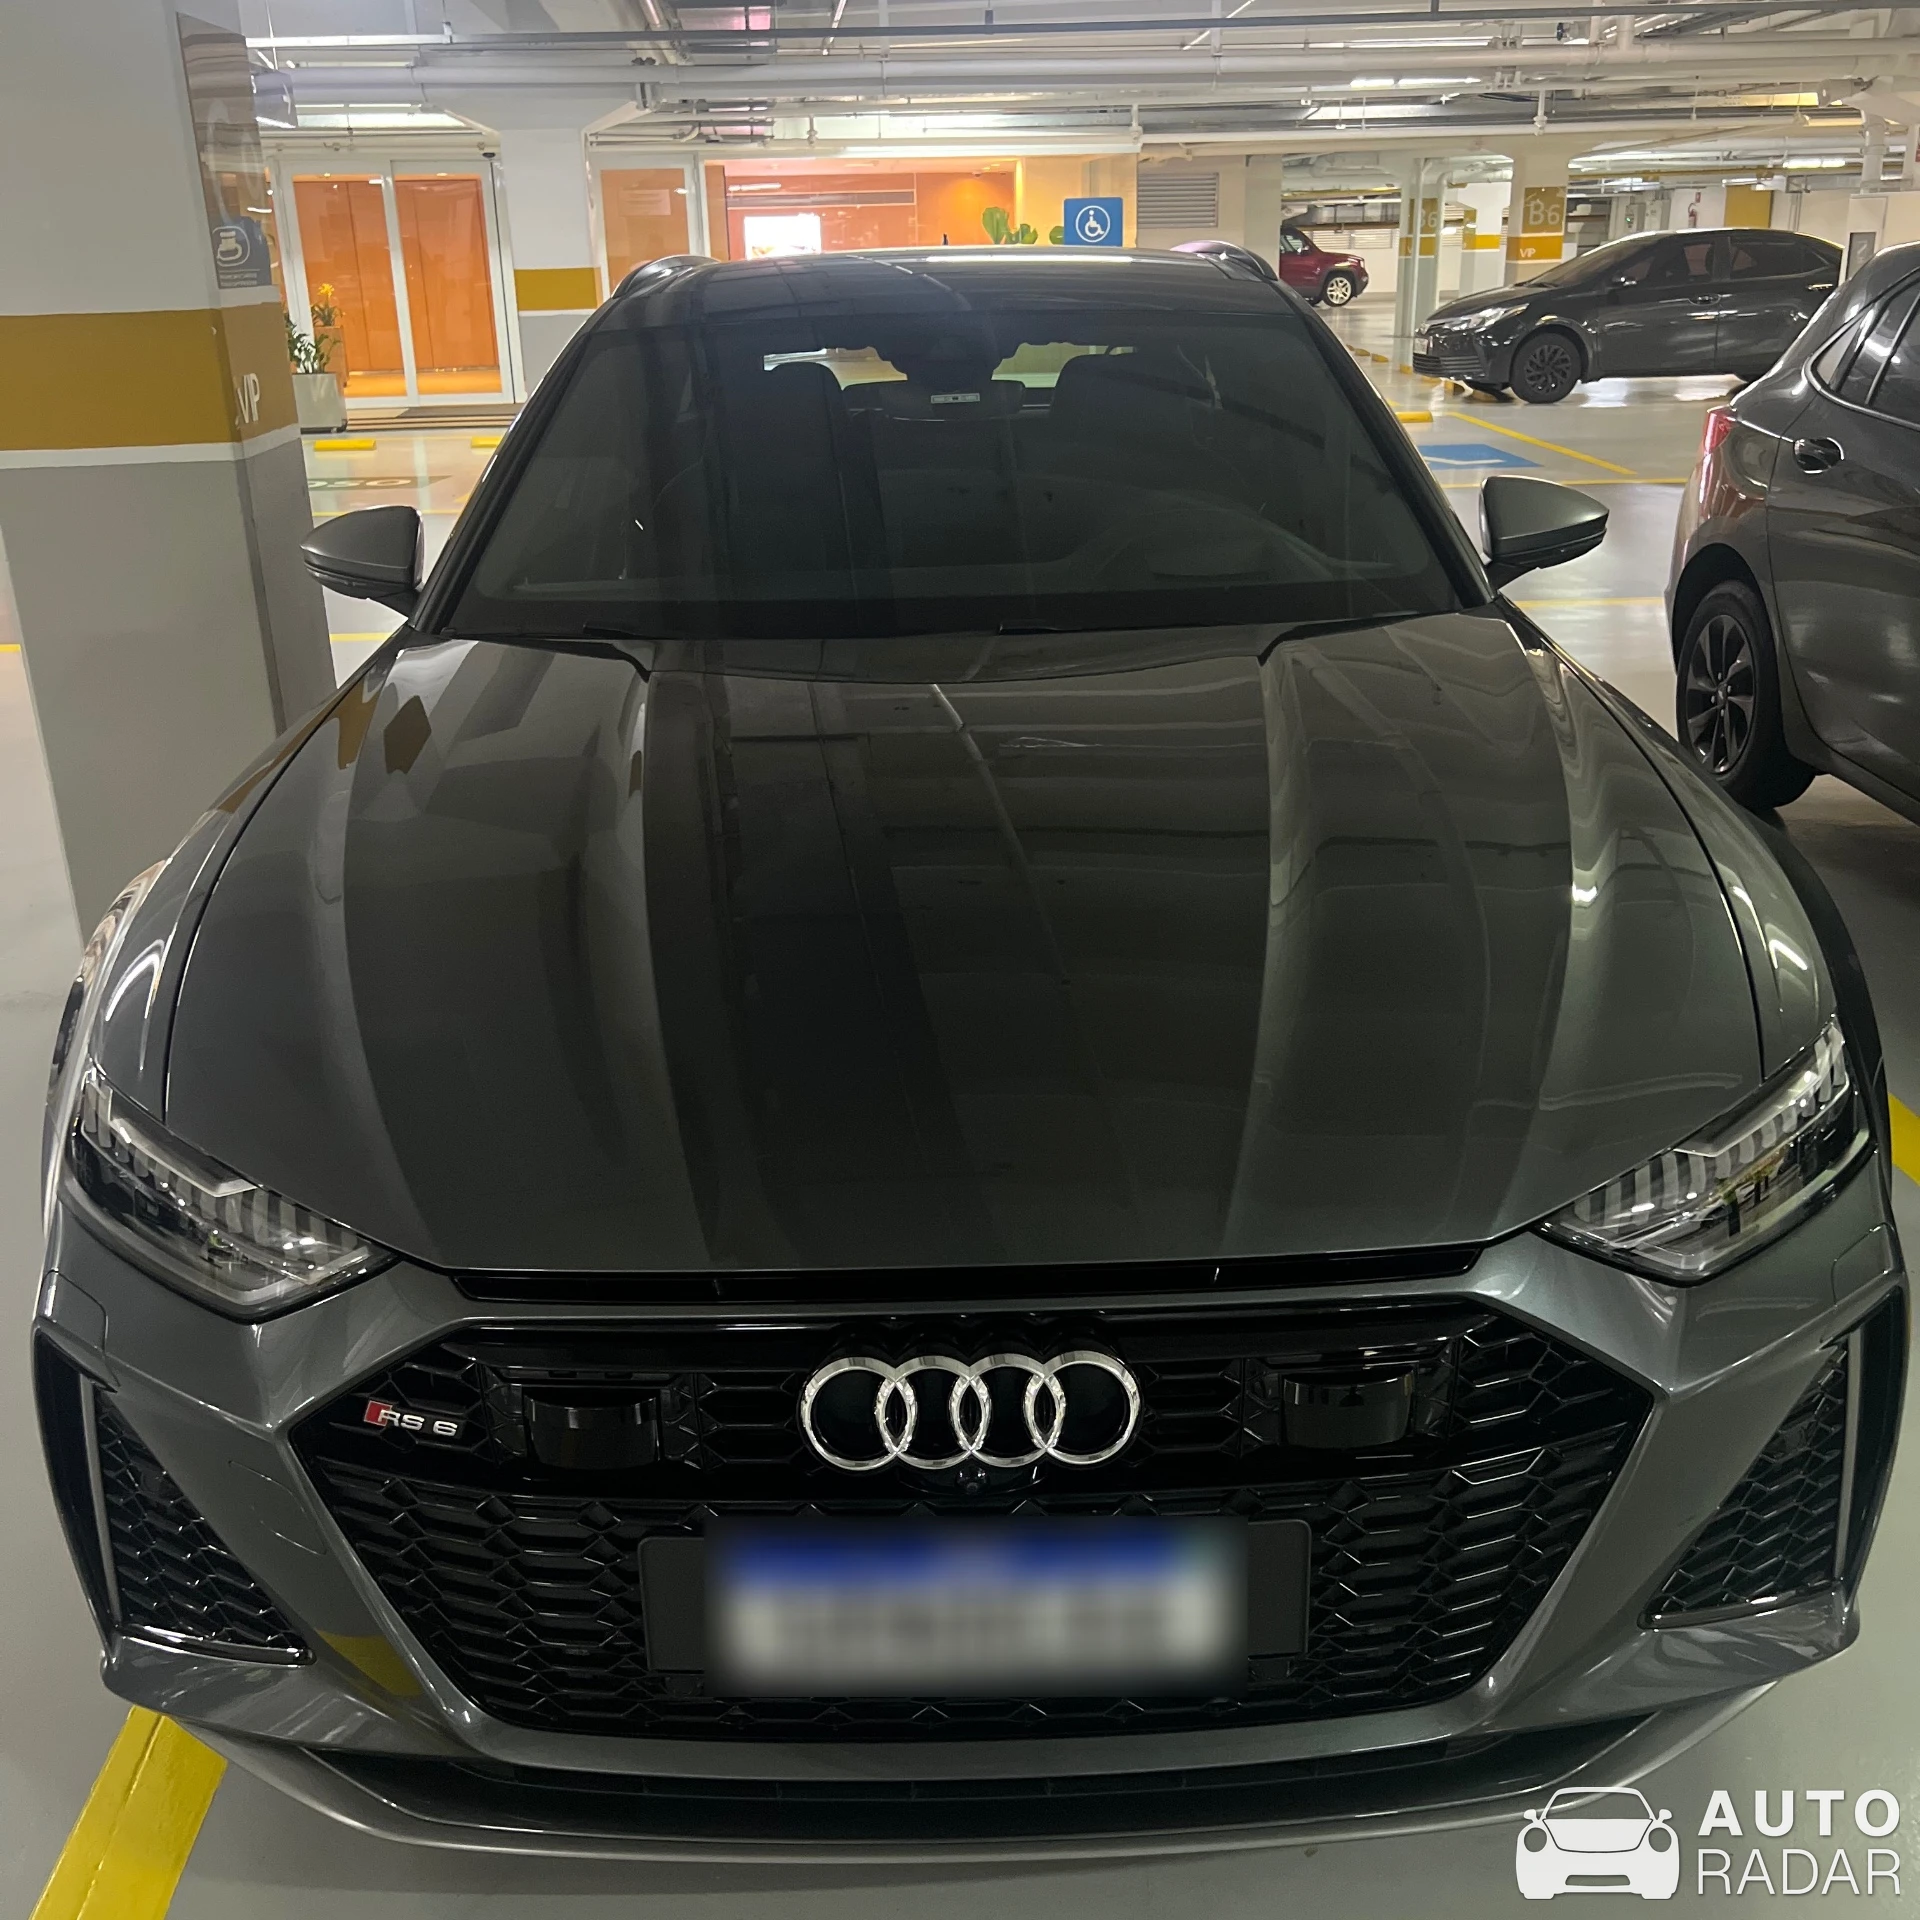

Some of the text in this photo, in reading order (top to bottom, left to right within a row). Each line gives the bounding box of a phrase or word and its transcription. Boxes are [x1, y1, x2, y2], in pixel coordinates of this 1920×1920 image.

[1528, 199, 1561, 226] B6
[1519, 248, 1536, 258] VIP
[237, 372, 260, 424] VIP
[377, 1408, 458, 1437] RS 6
